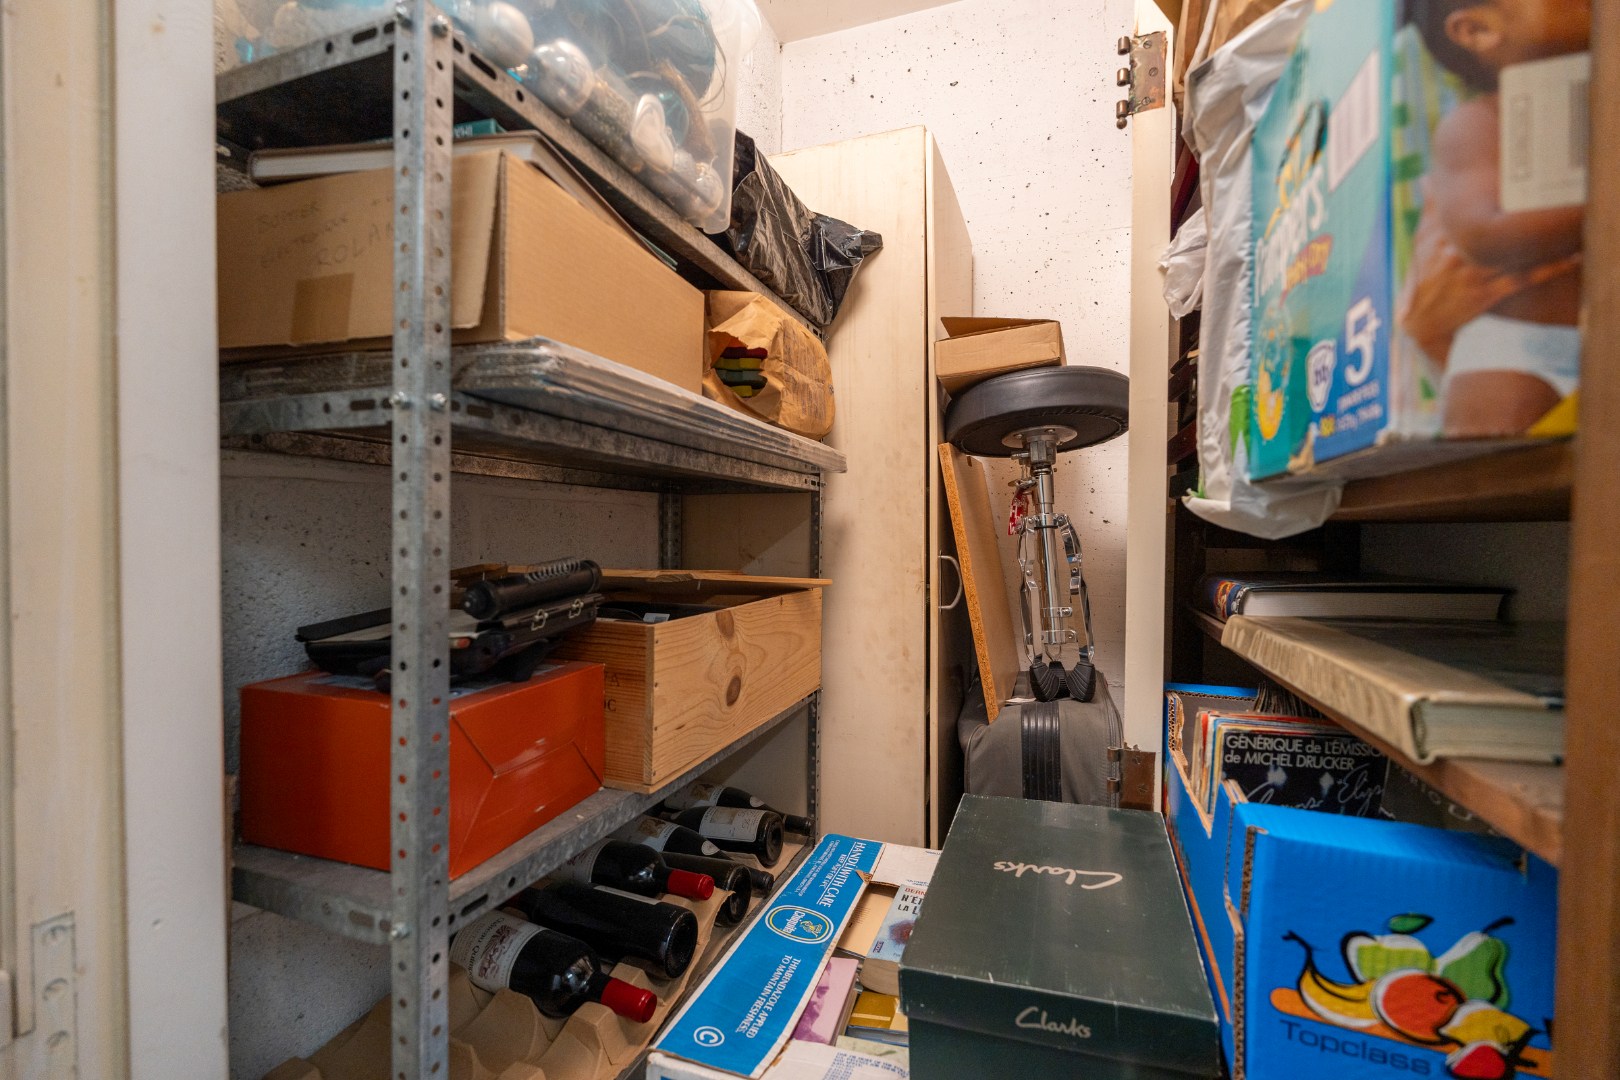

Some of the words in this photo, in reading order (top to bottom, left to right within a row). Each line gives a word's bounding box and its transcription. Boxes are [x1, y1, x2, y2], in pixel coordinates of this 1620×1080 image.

[1226, 734, 1302, 753] GÉNÉRIQUE
[1306, 740, 1322, 754] de
[1324, 738, 1384, 757] L'ÉMISSIO
[1224, 750, 1241, 764] de
[1244, 752, 1293, 768] MICHEL
[1296, 755, 1355, 770] DRUCKER
[844, 842, 867, 871] HANDL
[832, 869, 853, 888] WITH
[993, 861, 1123, 889] Clarks
[819, 887, 840, 908] CARE
[904, 887, 926, 896] BERN
[783, 911, 806, 934] Chiquita
[781, 954, 793, 965] TO
[761, 963, 787, 998] MAINTAIN
[764, 958, 802, 1012] THIABENDAZOLE
[746, 1010, 769, 1039] APPLIED
[1015, 1006, 1092, 1039] Clarks
[1279, 1019, 1432, 1076] Topclass
